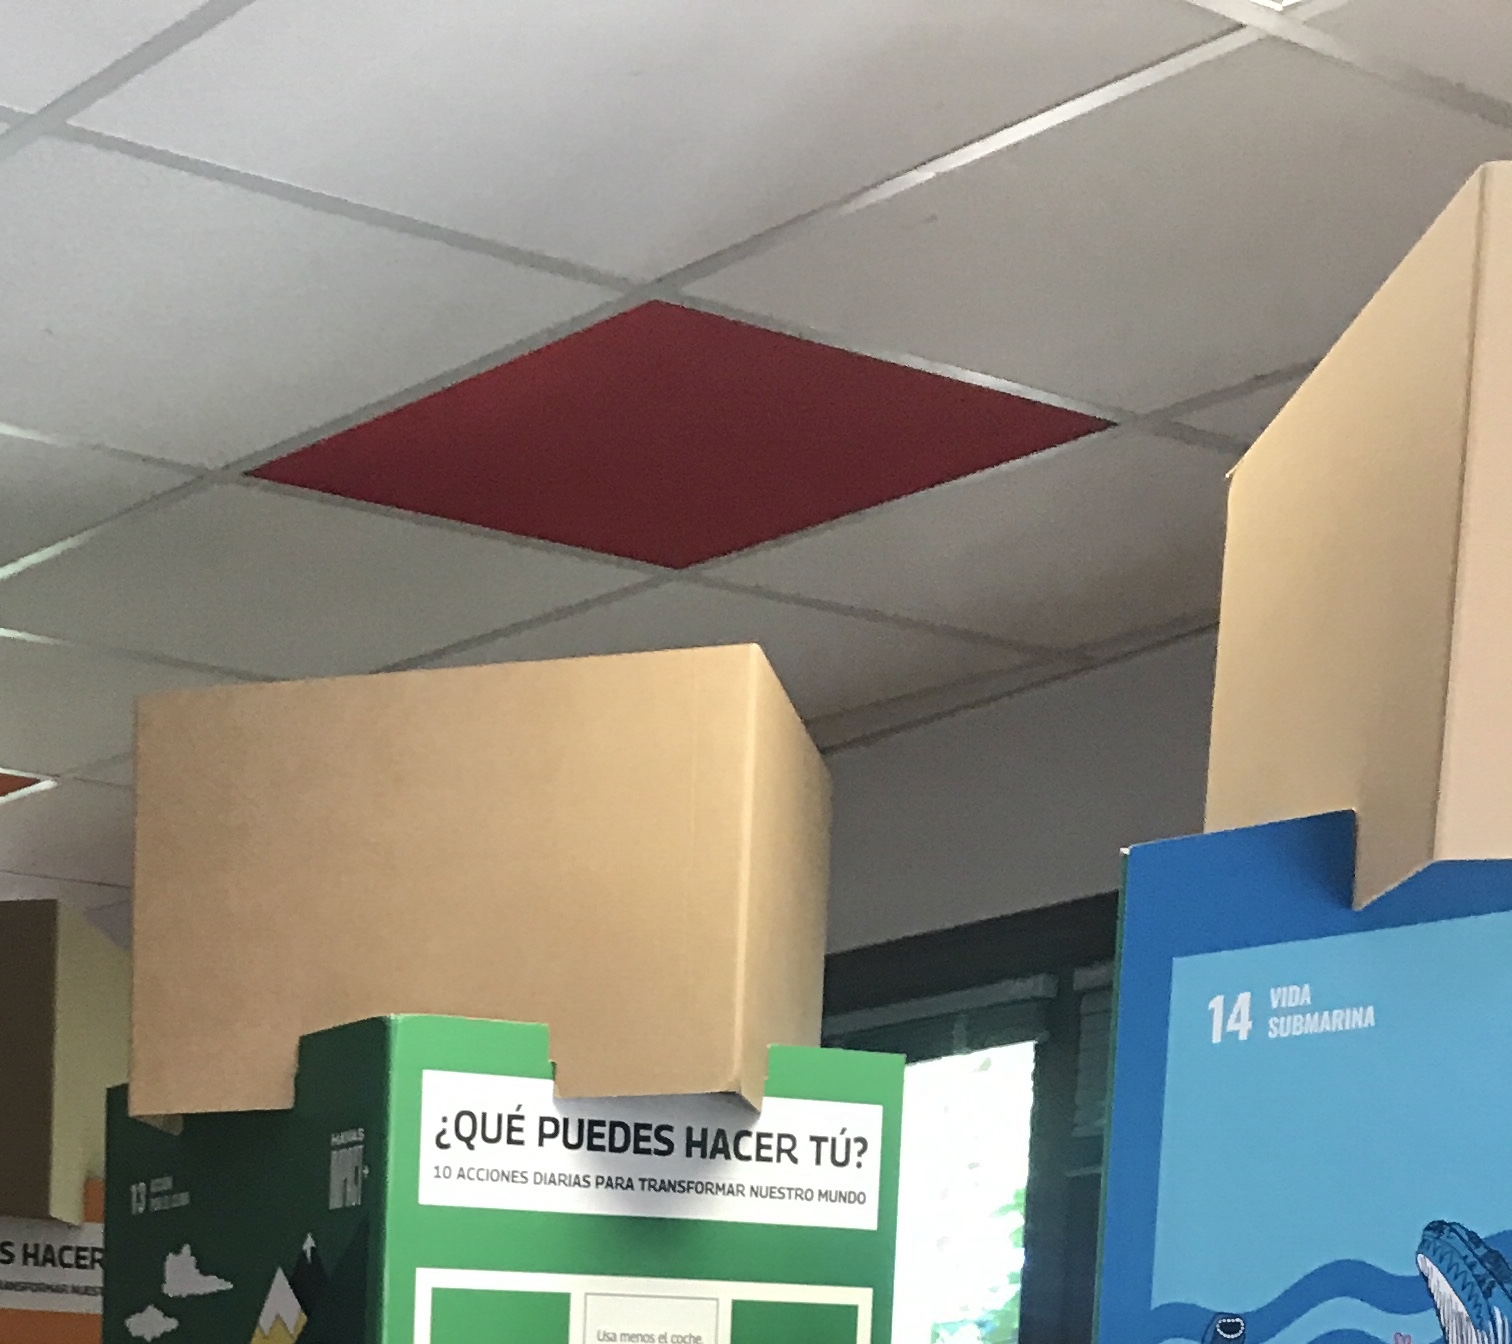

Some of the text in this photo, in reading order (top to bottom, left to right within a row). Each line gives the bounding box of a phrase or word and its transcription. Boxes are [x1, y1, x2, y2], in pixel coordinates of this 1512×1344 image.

[1270, 983, 1311, 1009] VIDA
[1208, 991, 1253, 1044] 14
[1268, 1005, 1375, 1039] SUBMARINA
[435, 1108, 868, 1169] ¿QUÉ PUEDES HACER TÚ?
[434, 1165, 867, 1205] 10 ACCIONES DIARIAS PARA TRANSFORMAR NUESTRO MUNDO
[21, 1242, 105, 1271] HACER
[596, 1330, 618, 1343] Usa
[619, 1332, 656, 1344] menos
[657, 1331, 668, 1344] el
